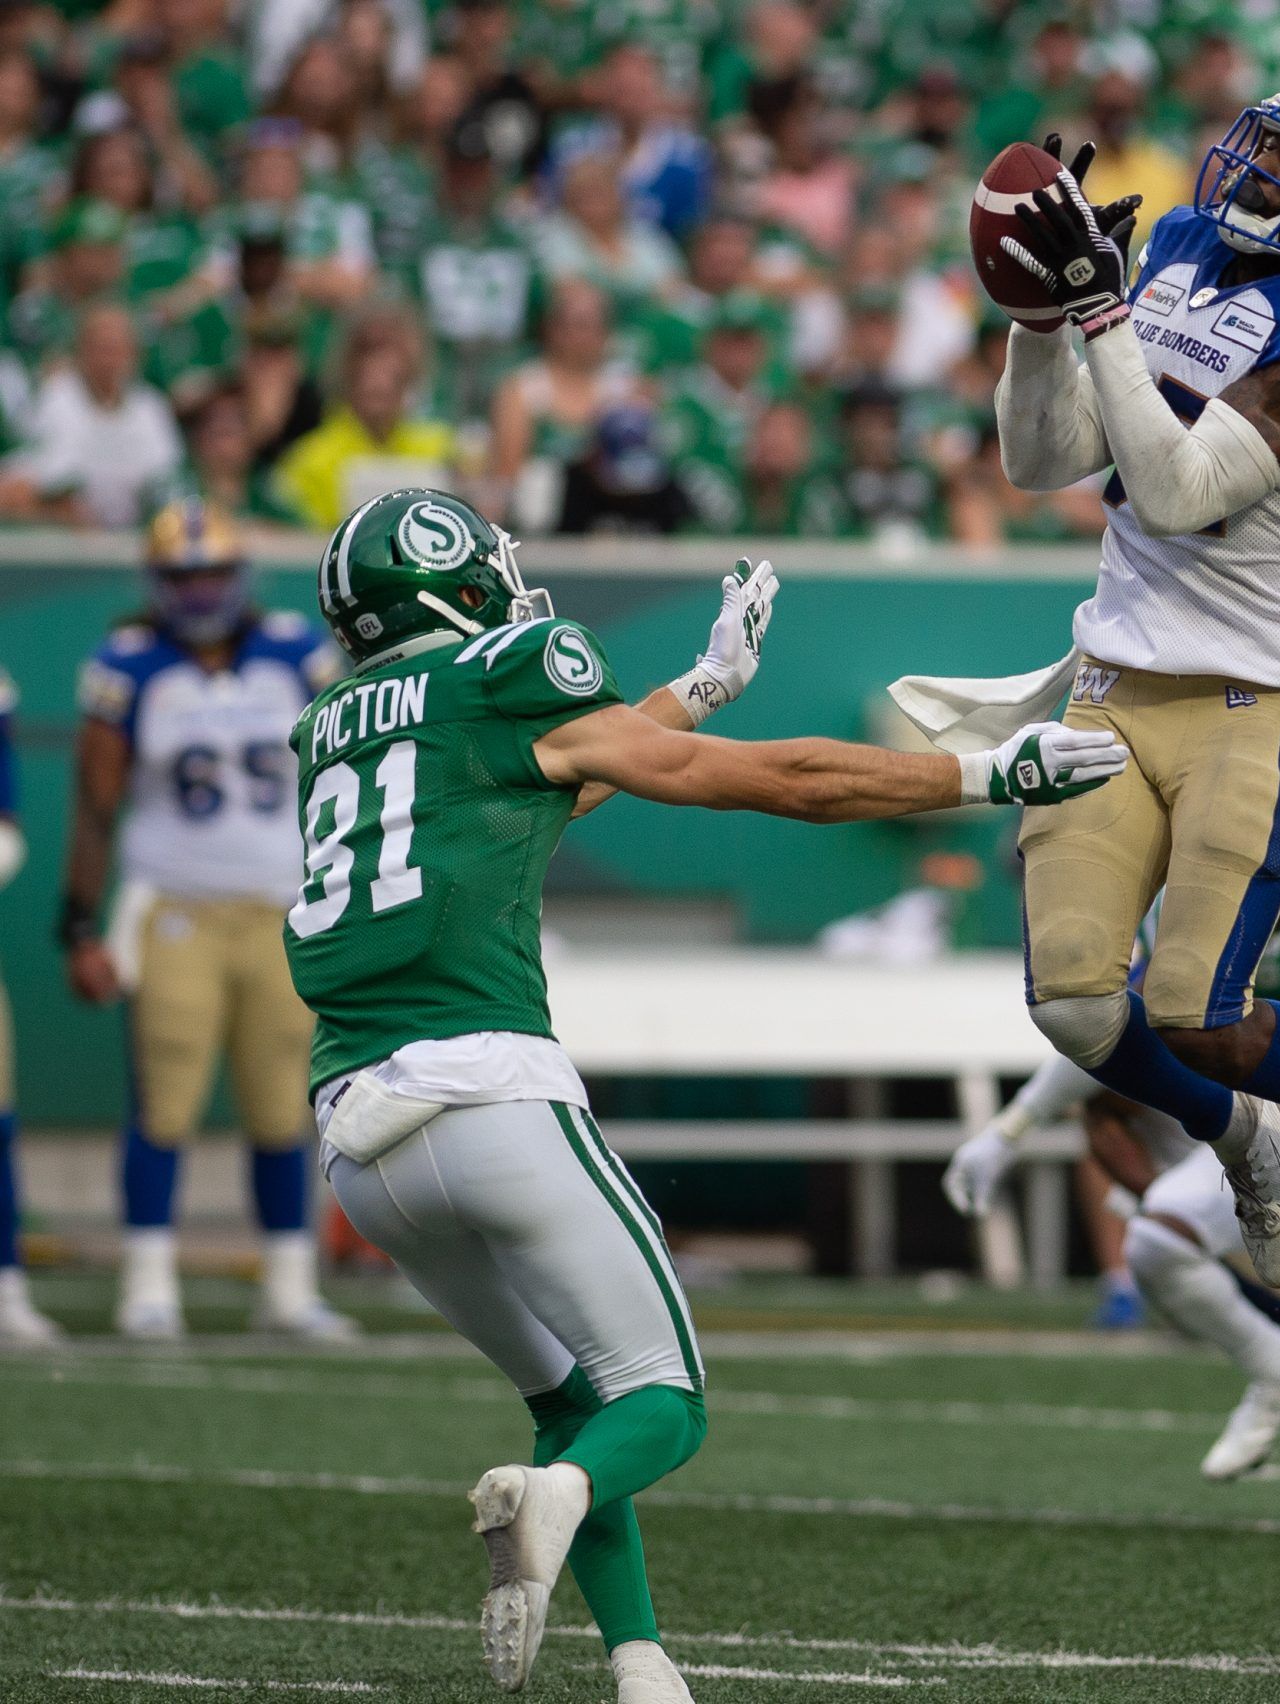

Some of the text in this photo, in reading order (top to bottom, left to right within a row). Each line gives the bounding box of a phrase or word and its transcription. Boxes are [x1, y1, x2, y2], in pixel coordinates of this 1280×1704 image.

[1070, 264, 1091, 281] CFL
[1150, 290, 1177, 308] Mark's
[1157, 328, 1231, 374] BOMBERS
[360, 619, 379, 635] CFL
[688, 681, 717, 704] AP
[1073, 664, 1121, 704] W
[312, 672, 430, 765] PICTON
[172, 743, 289, 825] 65
[288, 739, 424, 940] 81
